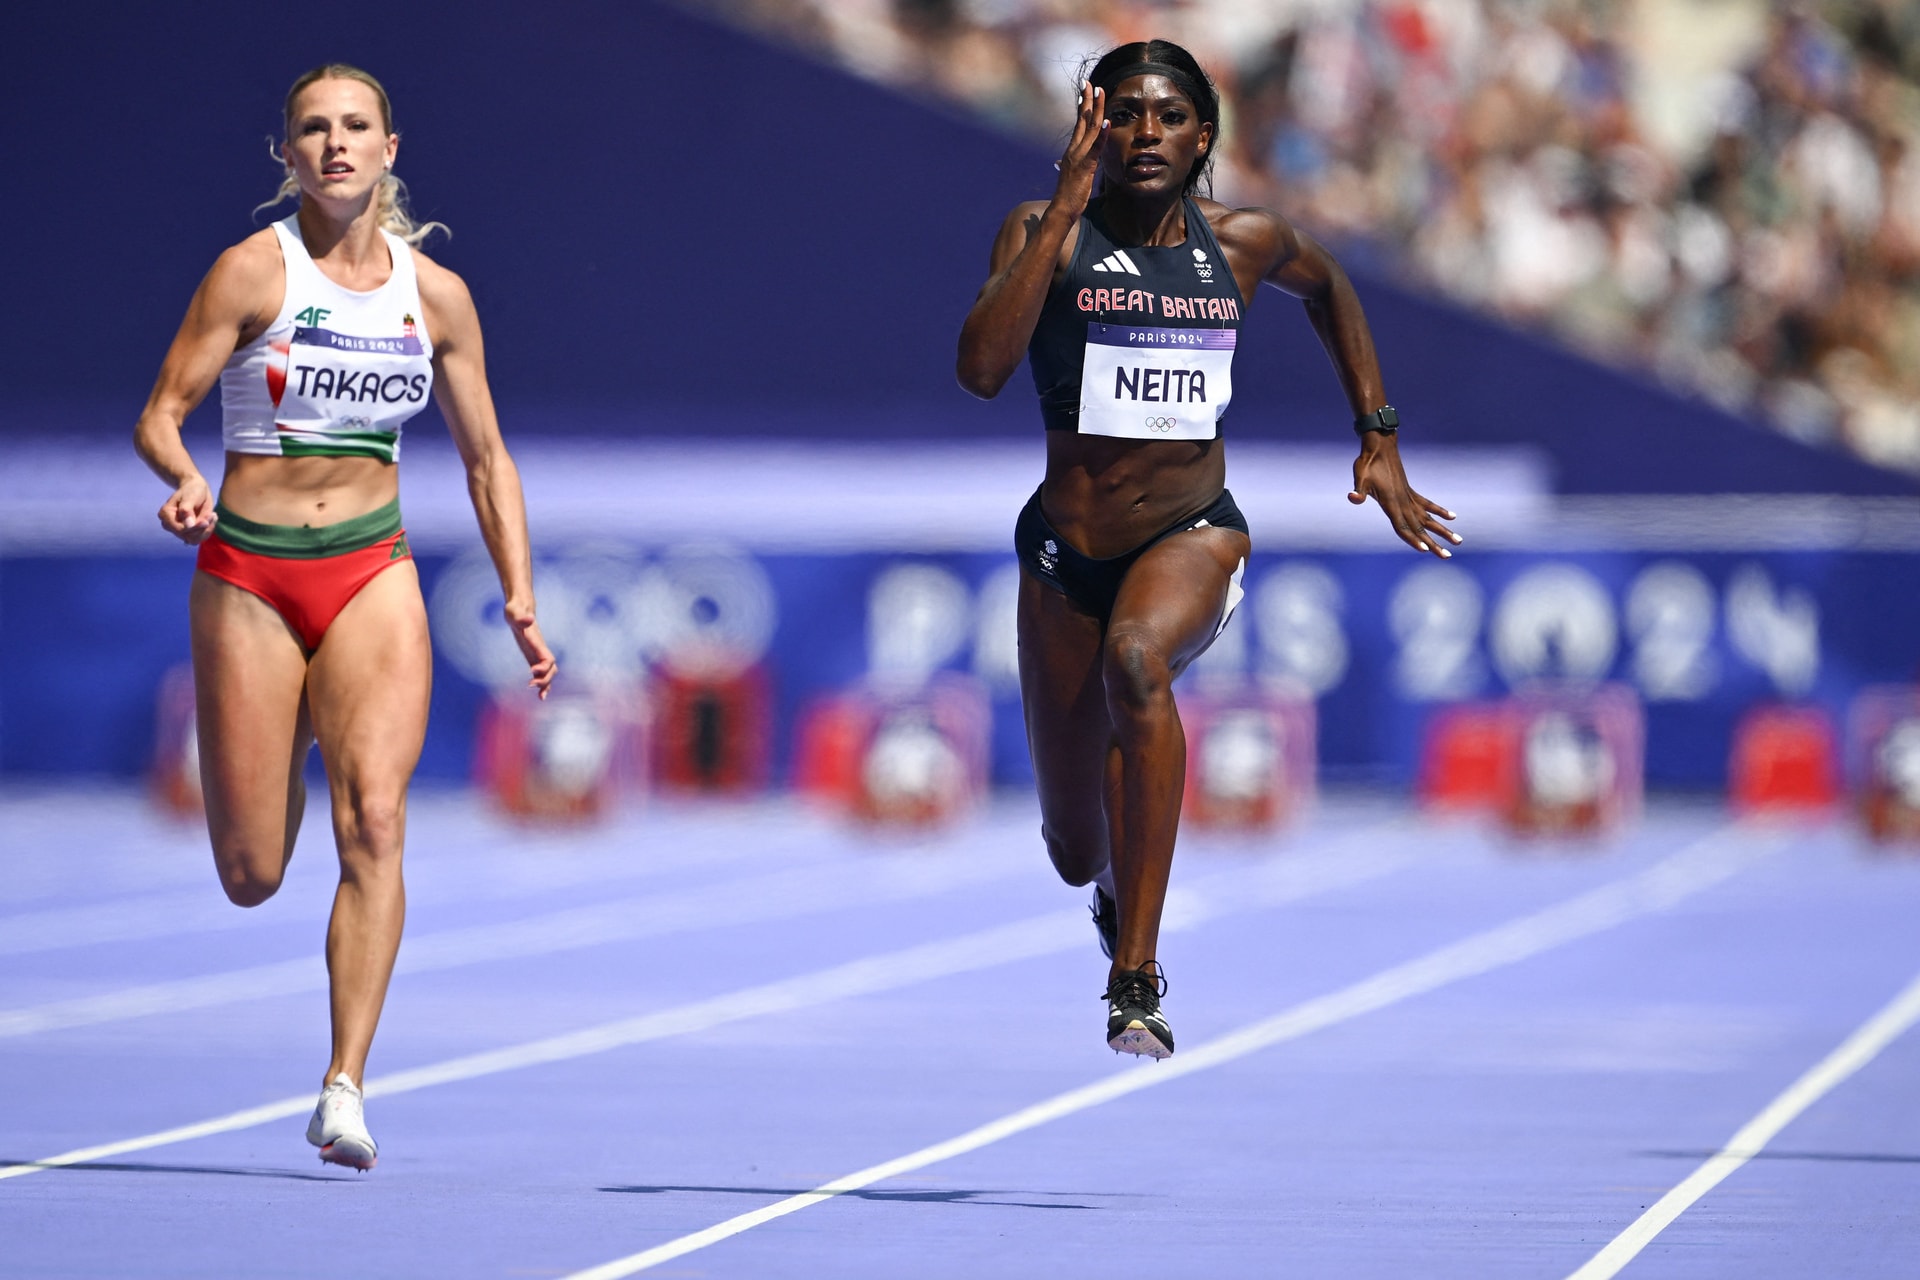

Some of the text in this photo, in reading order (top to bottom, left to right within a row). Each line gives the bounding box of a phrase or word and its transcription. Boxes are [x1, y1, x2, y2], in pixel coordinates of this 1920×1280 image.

[1077, 288, 1240, 320] GREAT BRITAIN
[331, 334, 404, 351] PARIS 2024
[1129, 332, 1203, 344] PARIS 2024
[295, 365, 427, 403] TAKACS
[1114, 366, 1207, 403] NEITA
[865, 561, 1820, 702] PIS 2024
